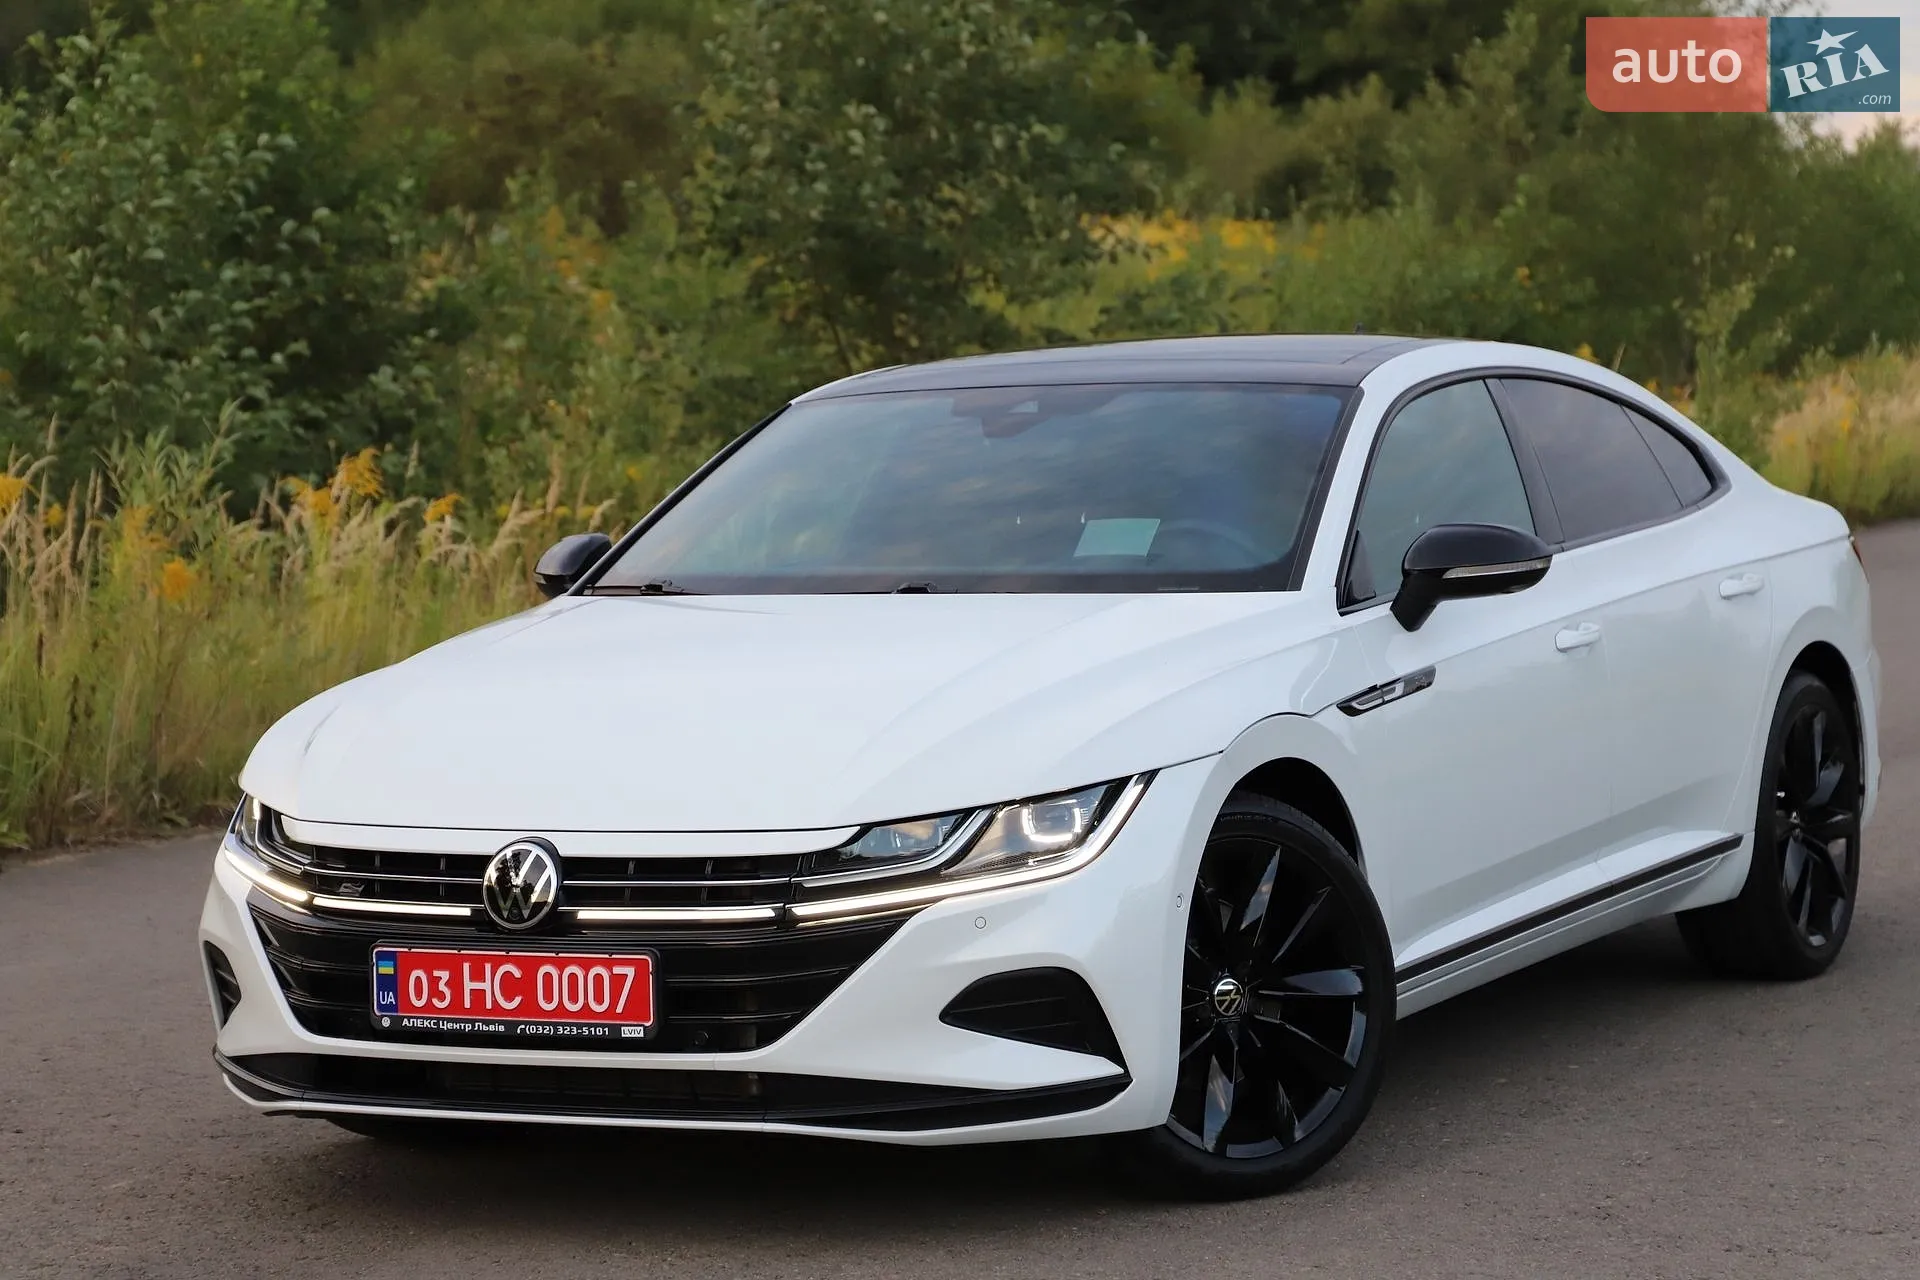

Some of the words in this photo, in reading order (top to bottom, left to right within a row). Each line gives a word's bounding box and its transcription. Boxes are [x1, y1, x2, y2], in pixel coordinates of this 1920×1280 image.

[408, 968, 452, 1009] 03
[462, 962, 523, 1010] HC
[536, 964, 636, 1014] 0007
[379, 990, 396, 1005] UA
[402, 1018, 437, 1028] АЛЕКС
[440, 1020, 472, 1032] Центр
[474, 1022, 505, 1032] Львів
[526, 1024, 554, 1035] (032)
[556, 1026, 609, 1036] 323-5101
[622, 1027, 643, 1037] LVIV
